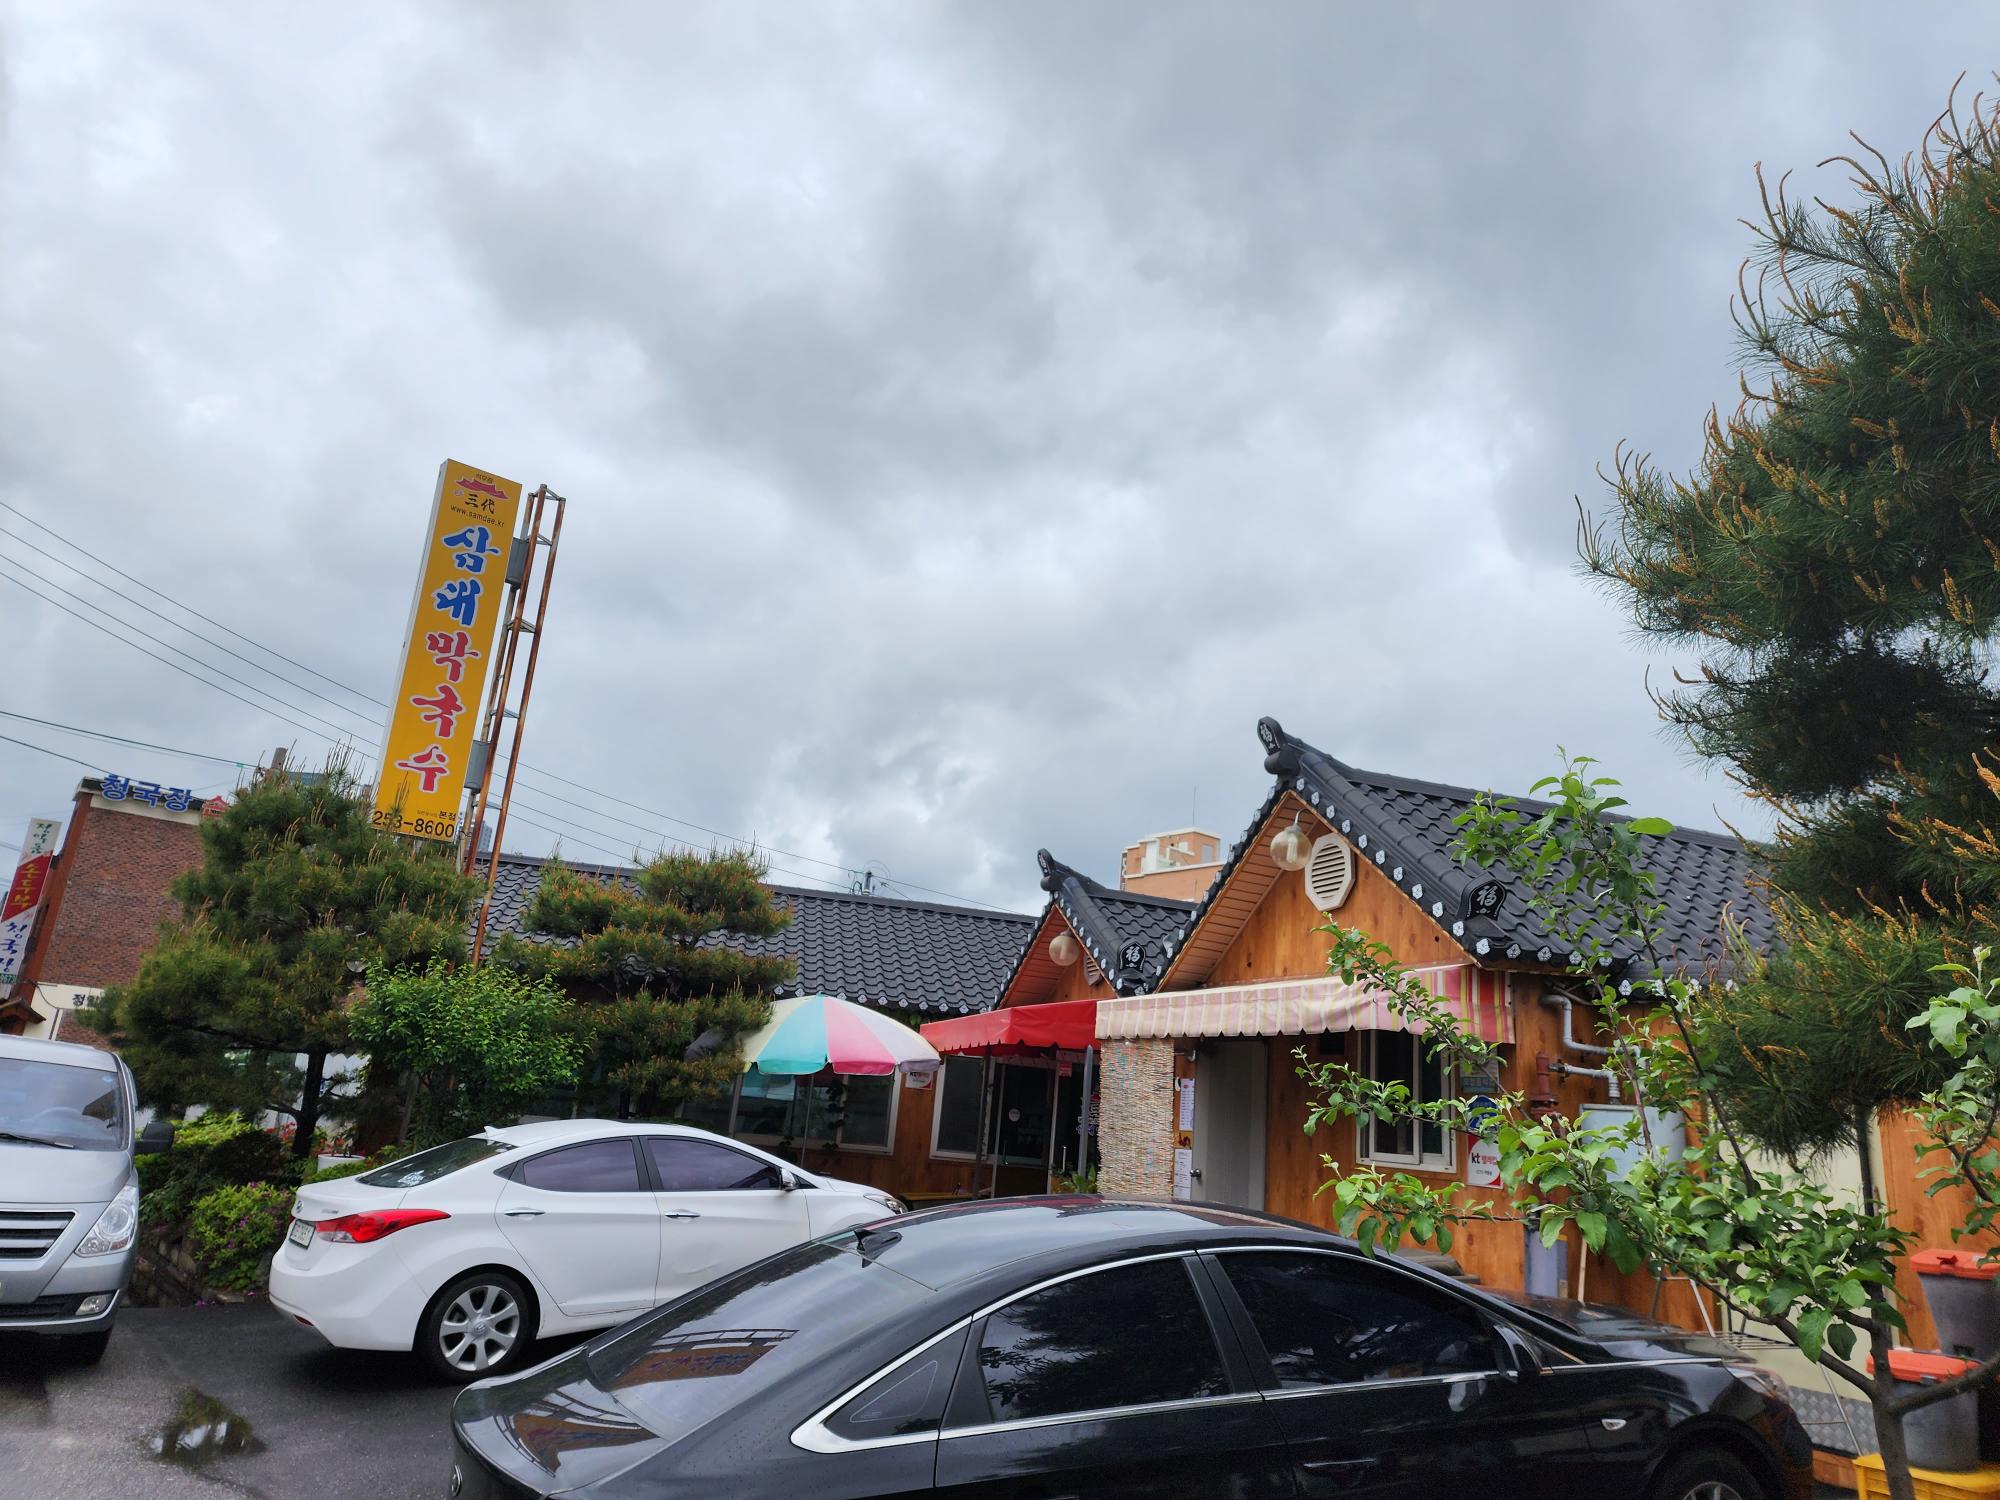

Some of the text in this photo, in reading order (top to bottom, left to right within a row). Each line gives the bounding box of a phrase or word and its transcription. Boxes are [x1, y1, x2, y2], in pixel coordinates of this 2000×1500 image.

[450, 504, 505, 528] www.samdae.kr
[395, 525, 500, 793] 삼대막국수
[100, 773, 193, 812] 청국장
[1476, 885, 1498, 907] 福
